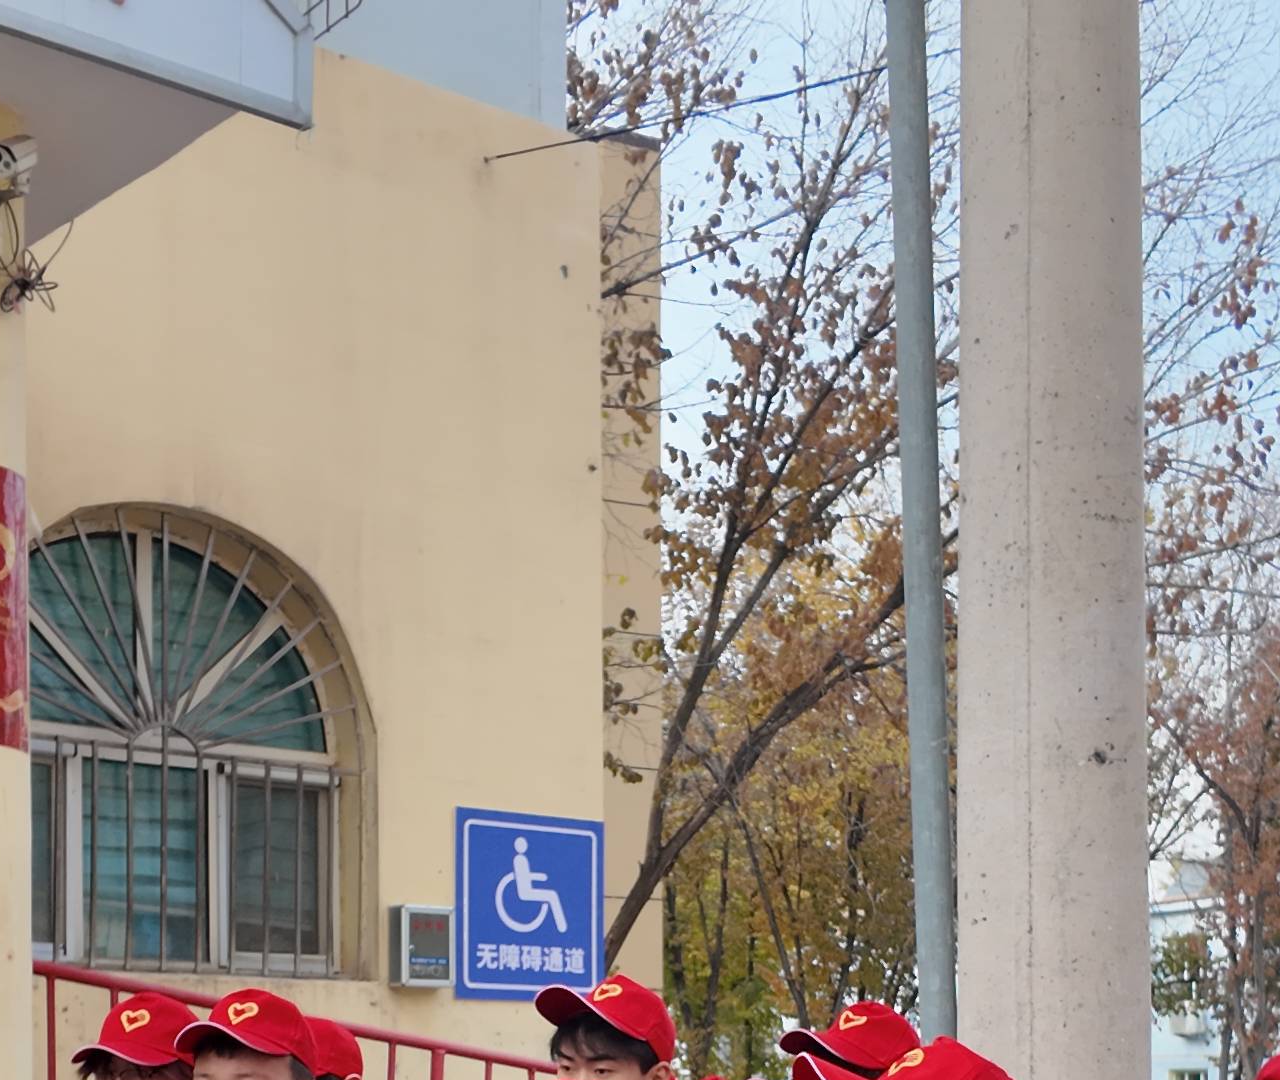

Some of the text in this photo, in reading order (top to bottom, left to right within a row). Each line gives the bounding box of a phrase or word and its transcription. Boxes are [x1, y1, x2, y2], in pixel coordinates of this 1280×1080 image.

[476, 943, 586, 975] 无障碍通道
